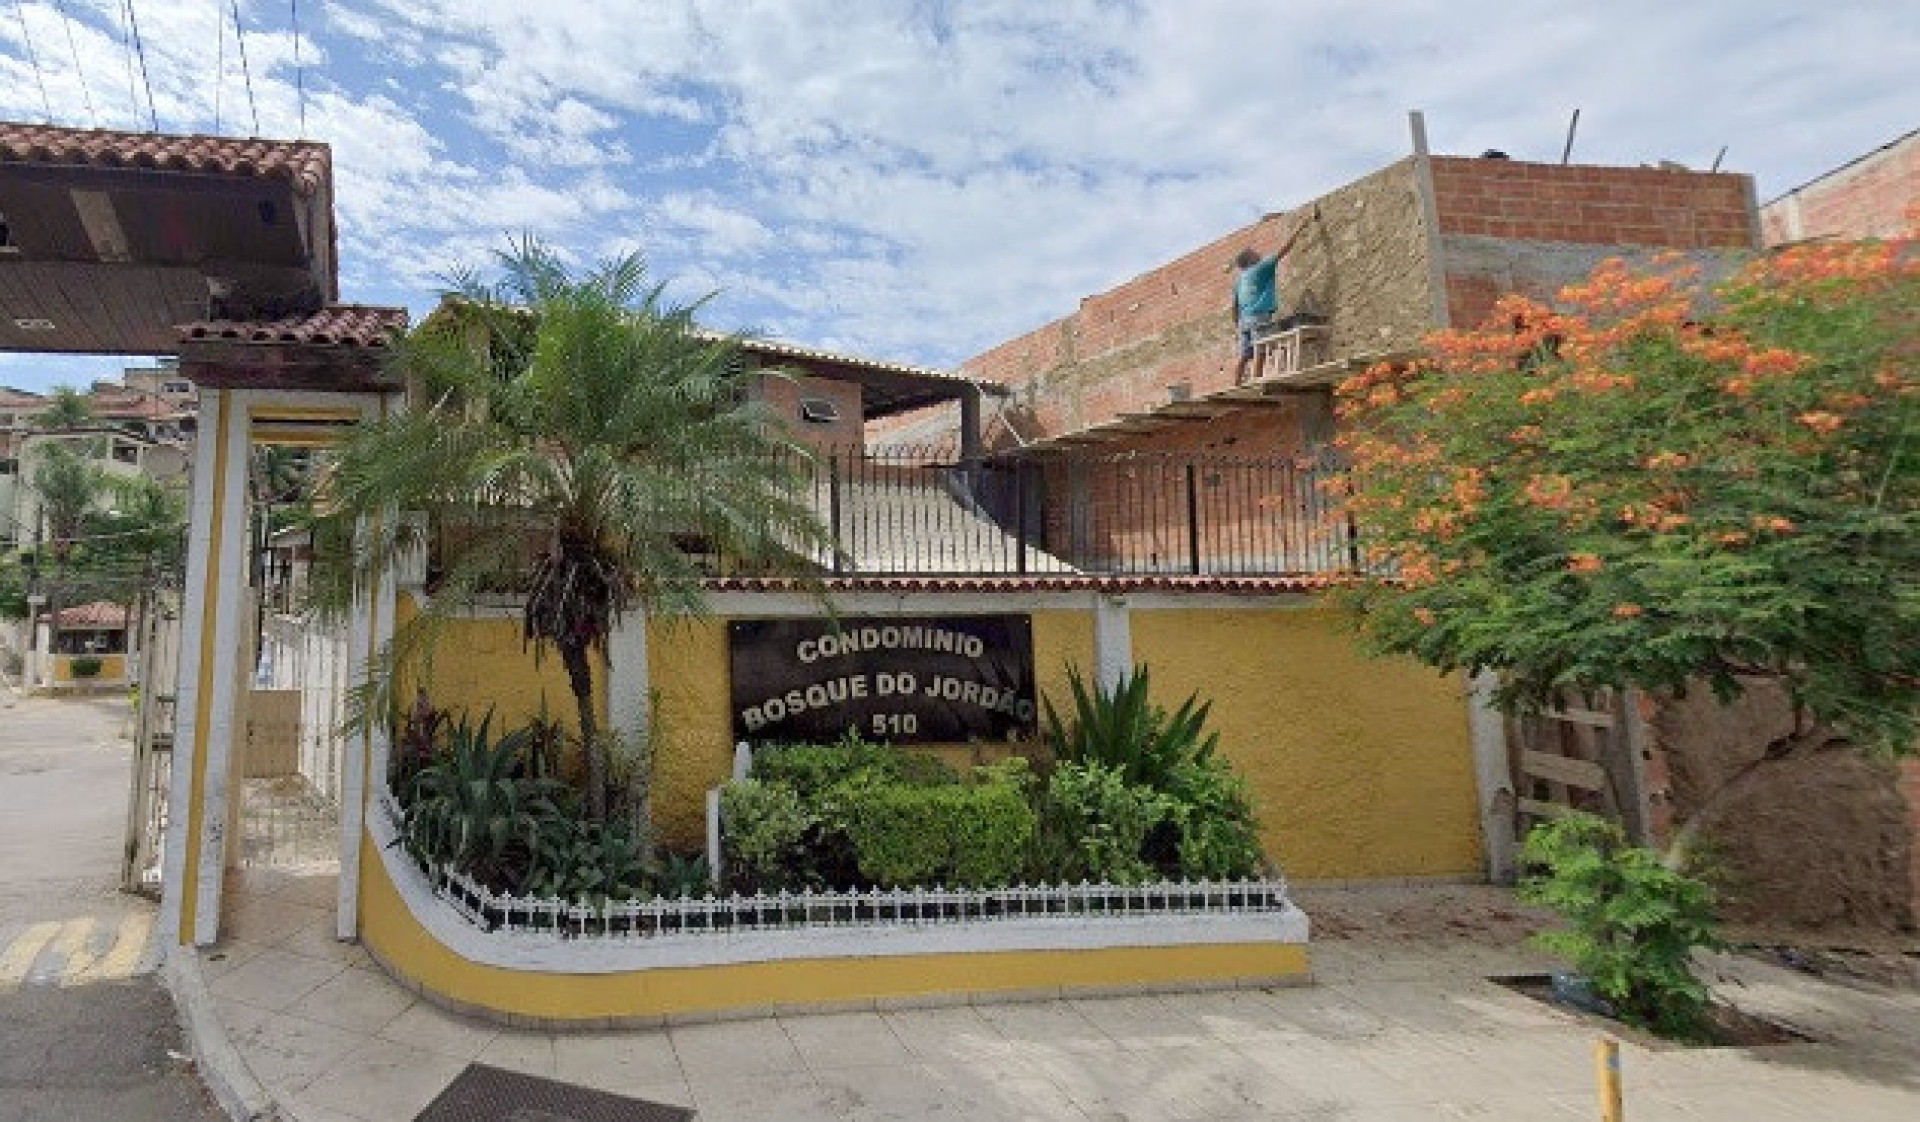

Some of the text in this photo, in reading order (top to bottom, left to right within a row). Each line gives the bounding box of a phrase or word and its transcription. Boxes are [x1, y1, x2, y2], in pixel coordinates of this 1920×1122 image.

[796, 625, 984, 664] CONDOMINIO
[741, 674, 868, 730] BOSQUE
[876, 672, 917, 695] DO
[872, 713, 917, 734] 510
